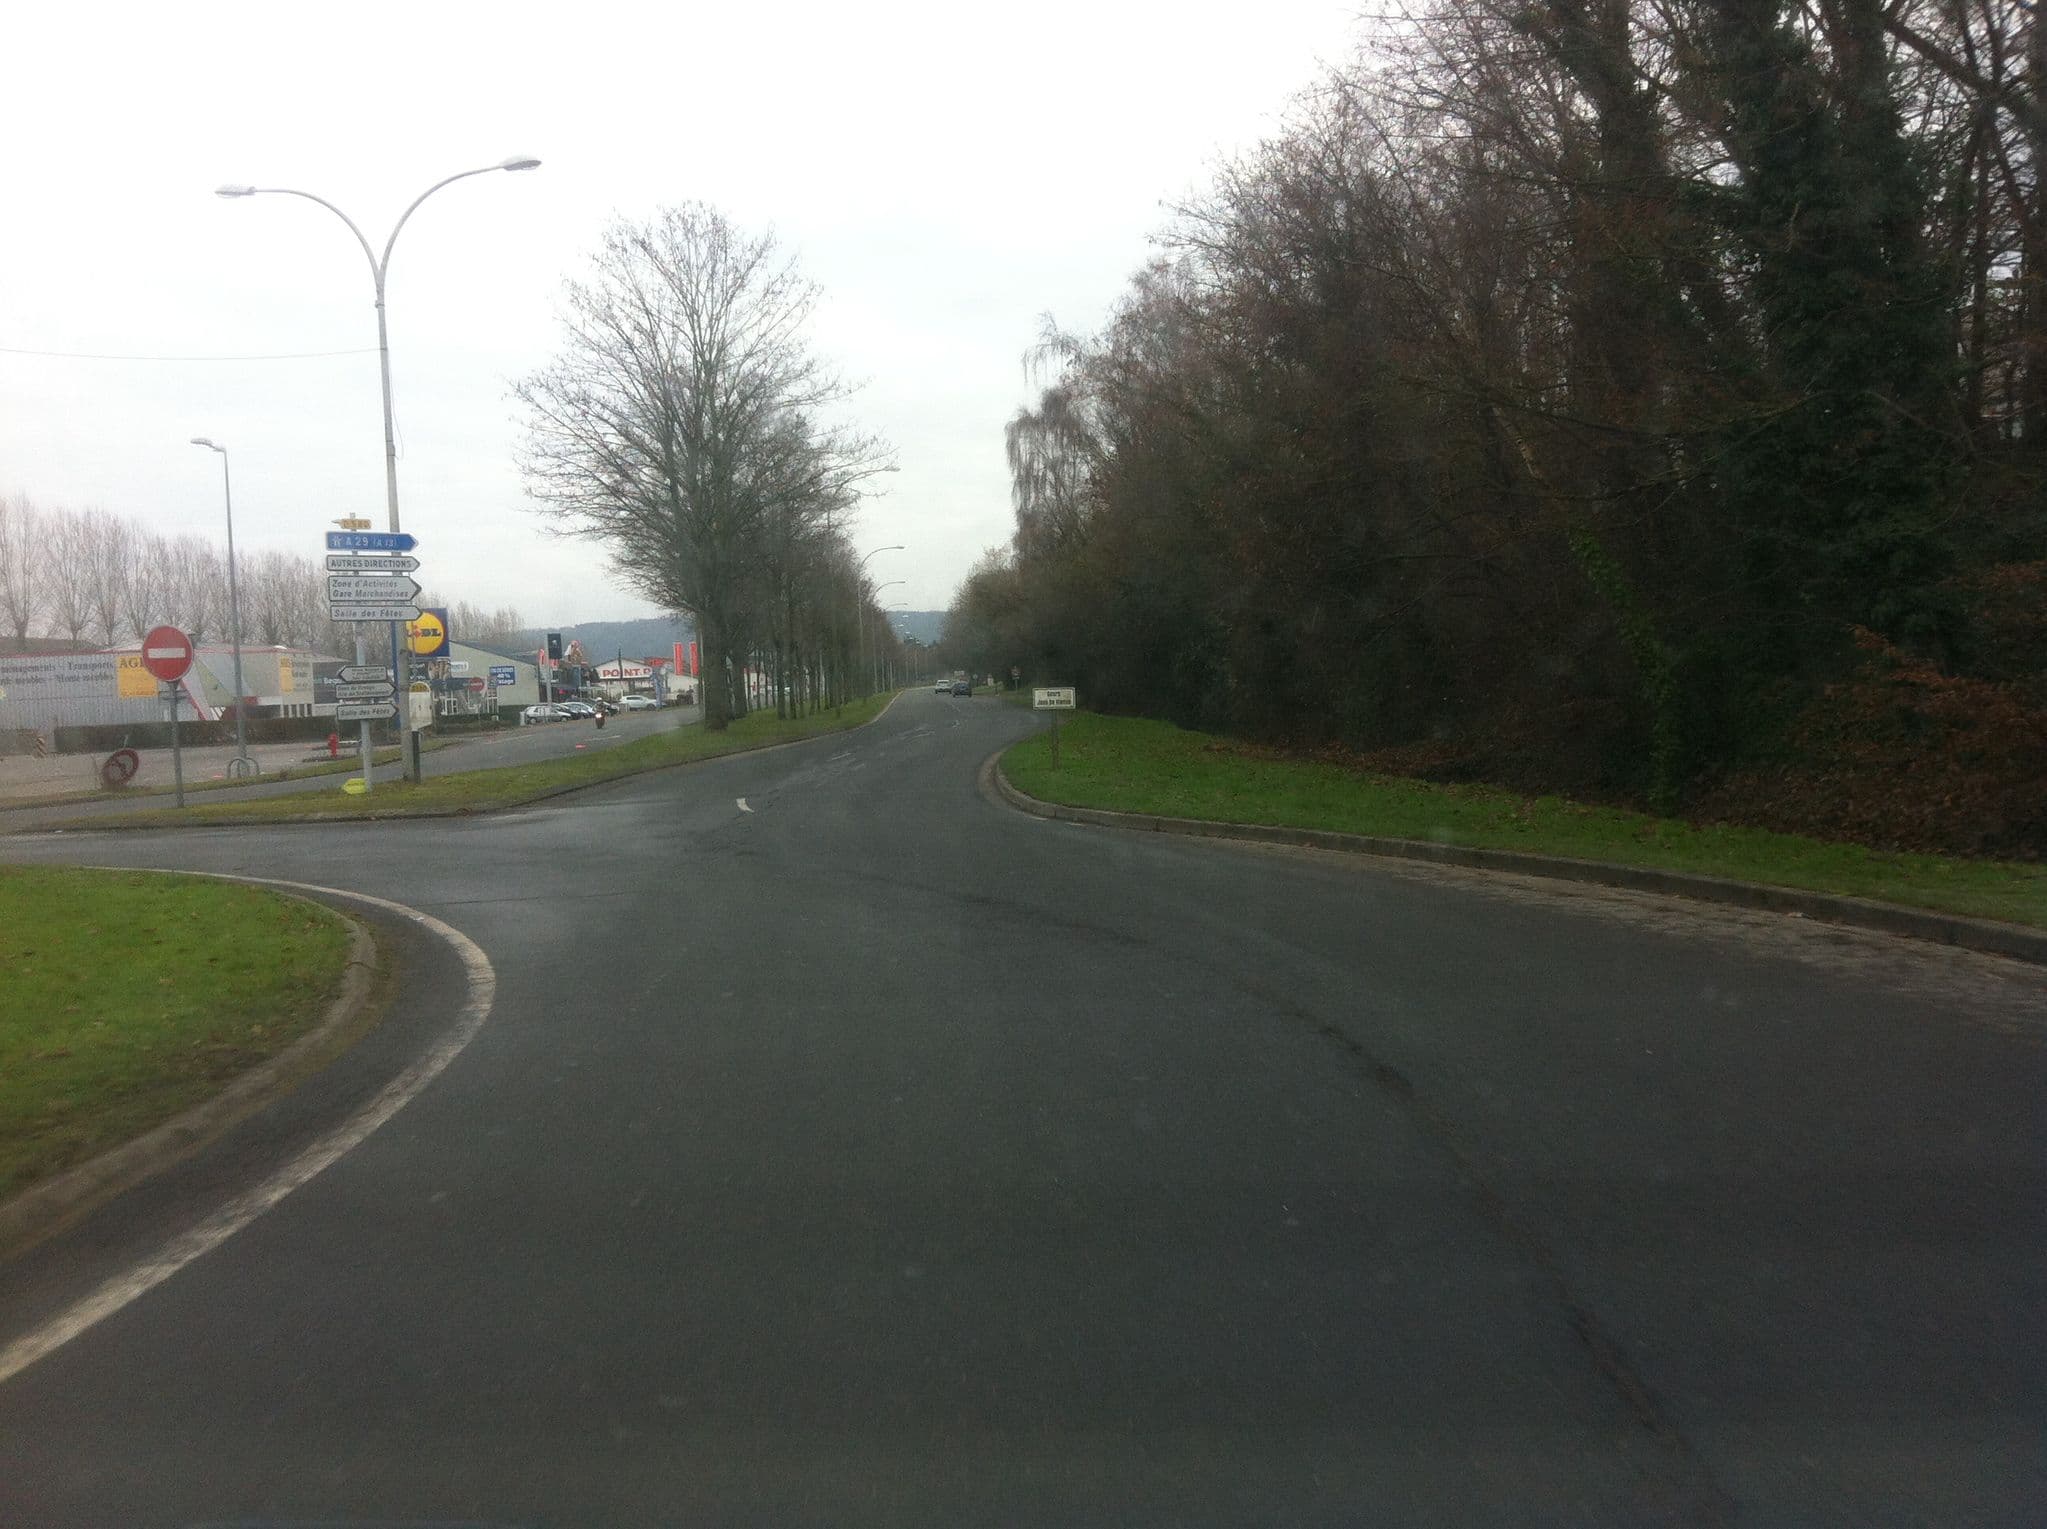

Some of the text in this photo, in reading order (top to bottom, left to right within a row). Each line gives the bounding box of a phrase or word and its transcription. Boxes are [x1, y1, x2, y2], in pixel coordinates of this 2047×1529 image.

[345, 536, 352, 546] A
[355, 536, 369, 547] 29
[331, 559, 412, 568] AUTRES DIRECTIONS
[332, 579, 352, 588] Zone
[332, 589, 353, 598] Gare
[334, 609, 357, 617] Salle
[361, 608, 376, 617] des
[602, 667, 651, 677] PONT.P
